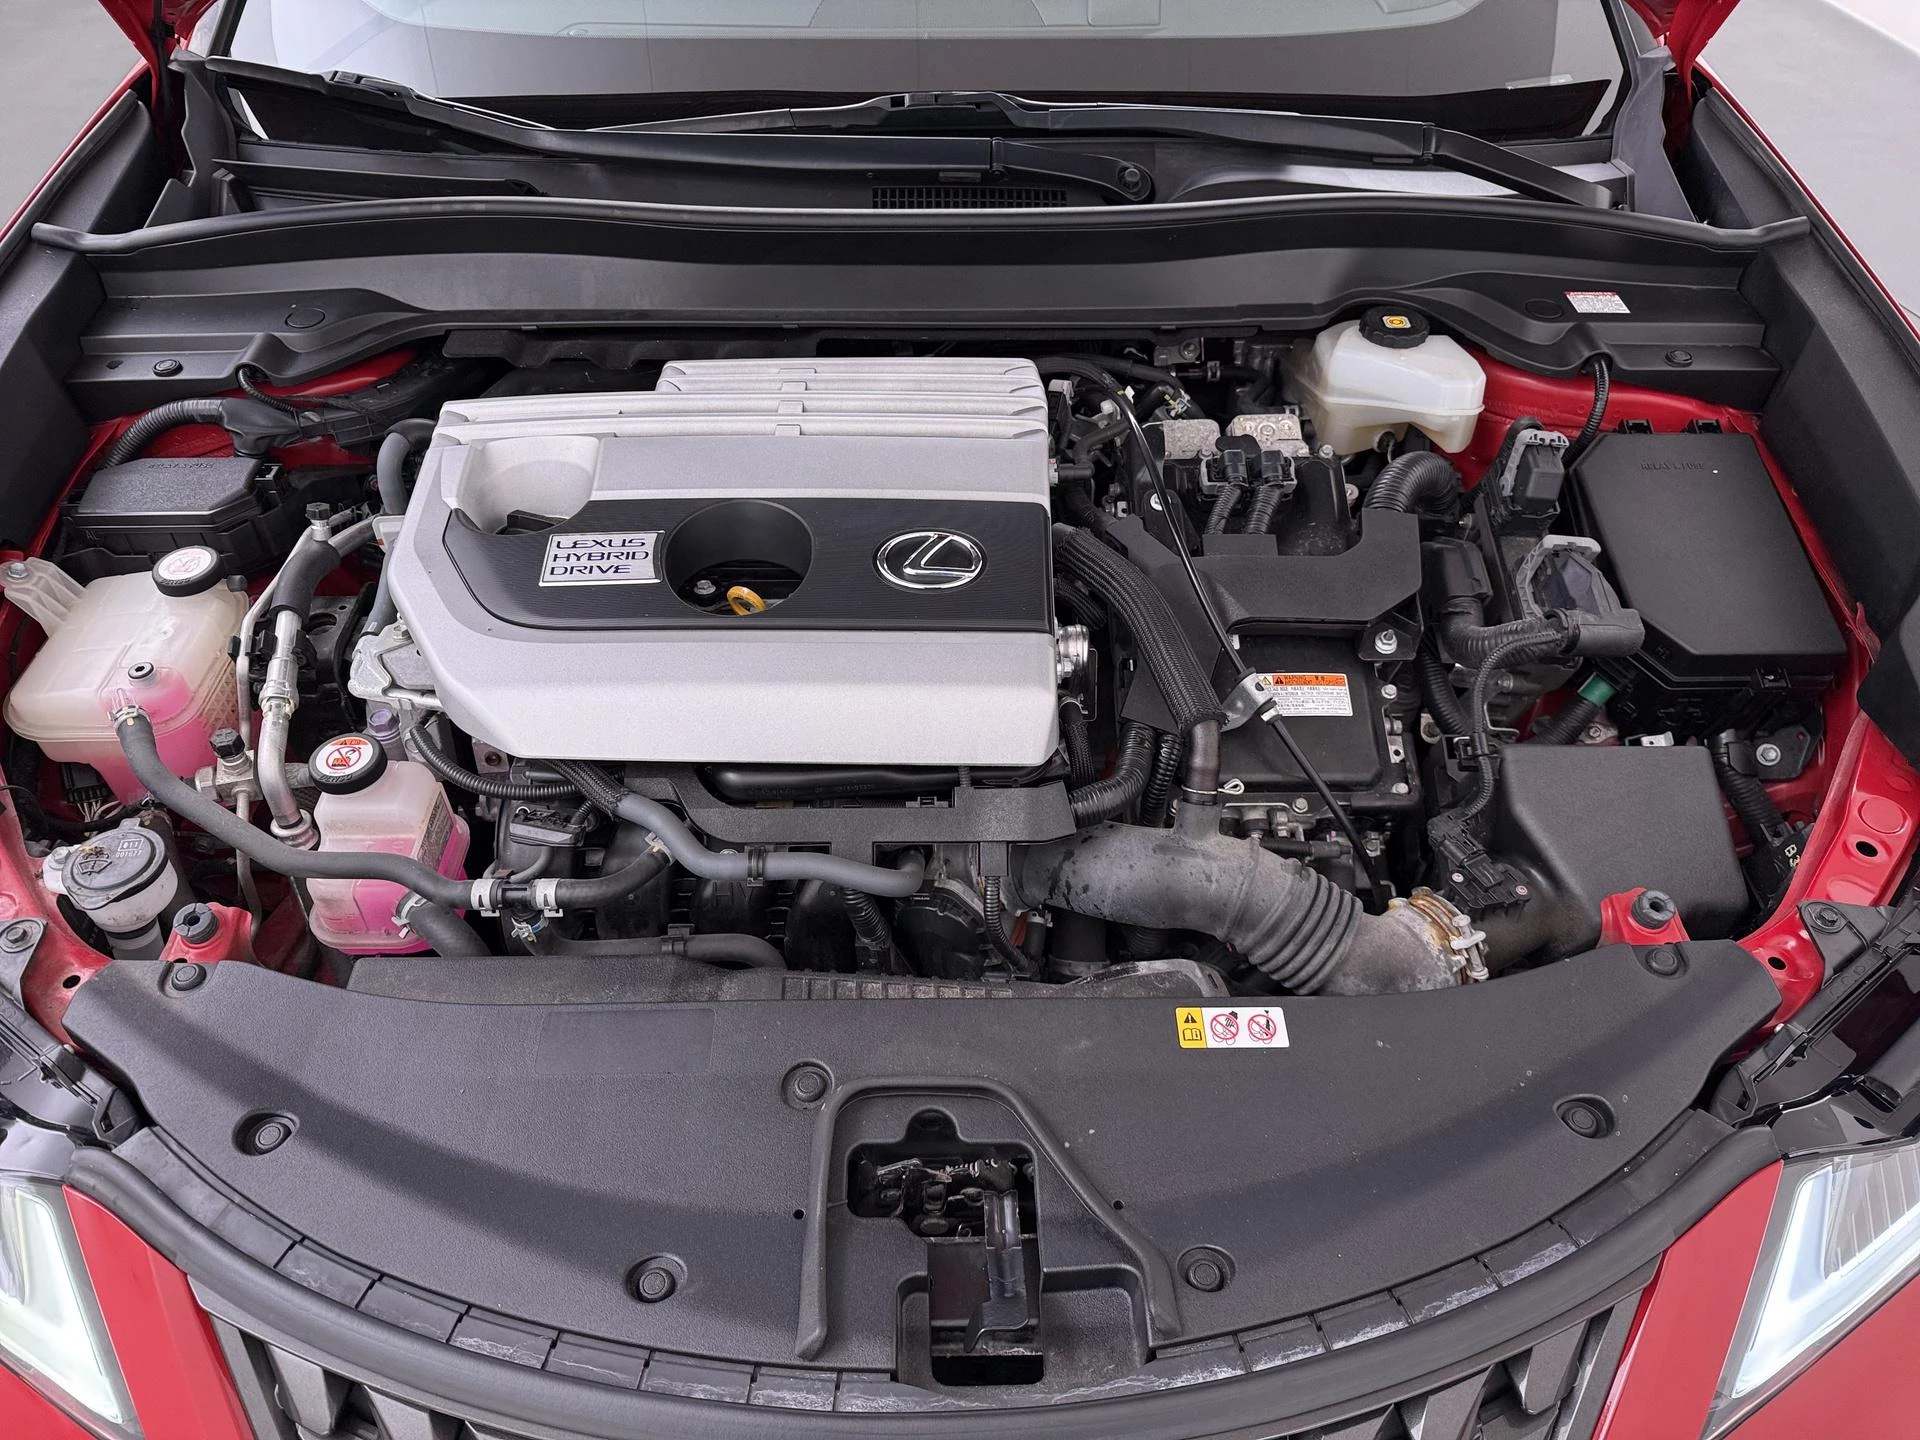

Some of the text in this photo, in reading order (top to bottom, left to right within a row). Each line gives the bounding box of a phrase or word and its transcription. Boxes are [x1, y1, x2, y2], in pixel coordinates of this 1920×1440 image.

[556, 538, 646, 550] LEXUS
[552, 551, 650, 562] HYBRID
[549, 564, 633, 576] DRIVE
